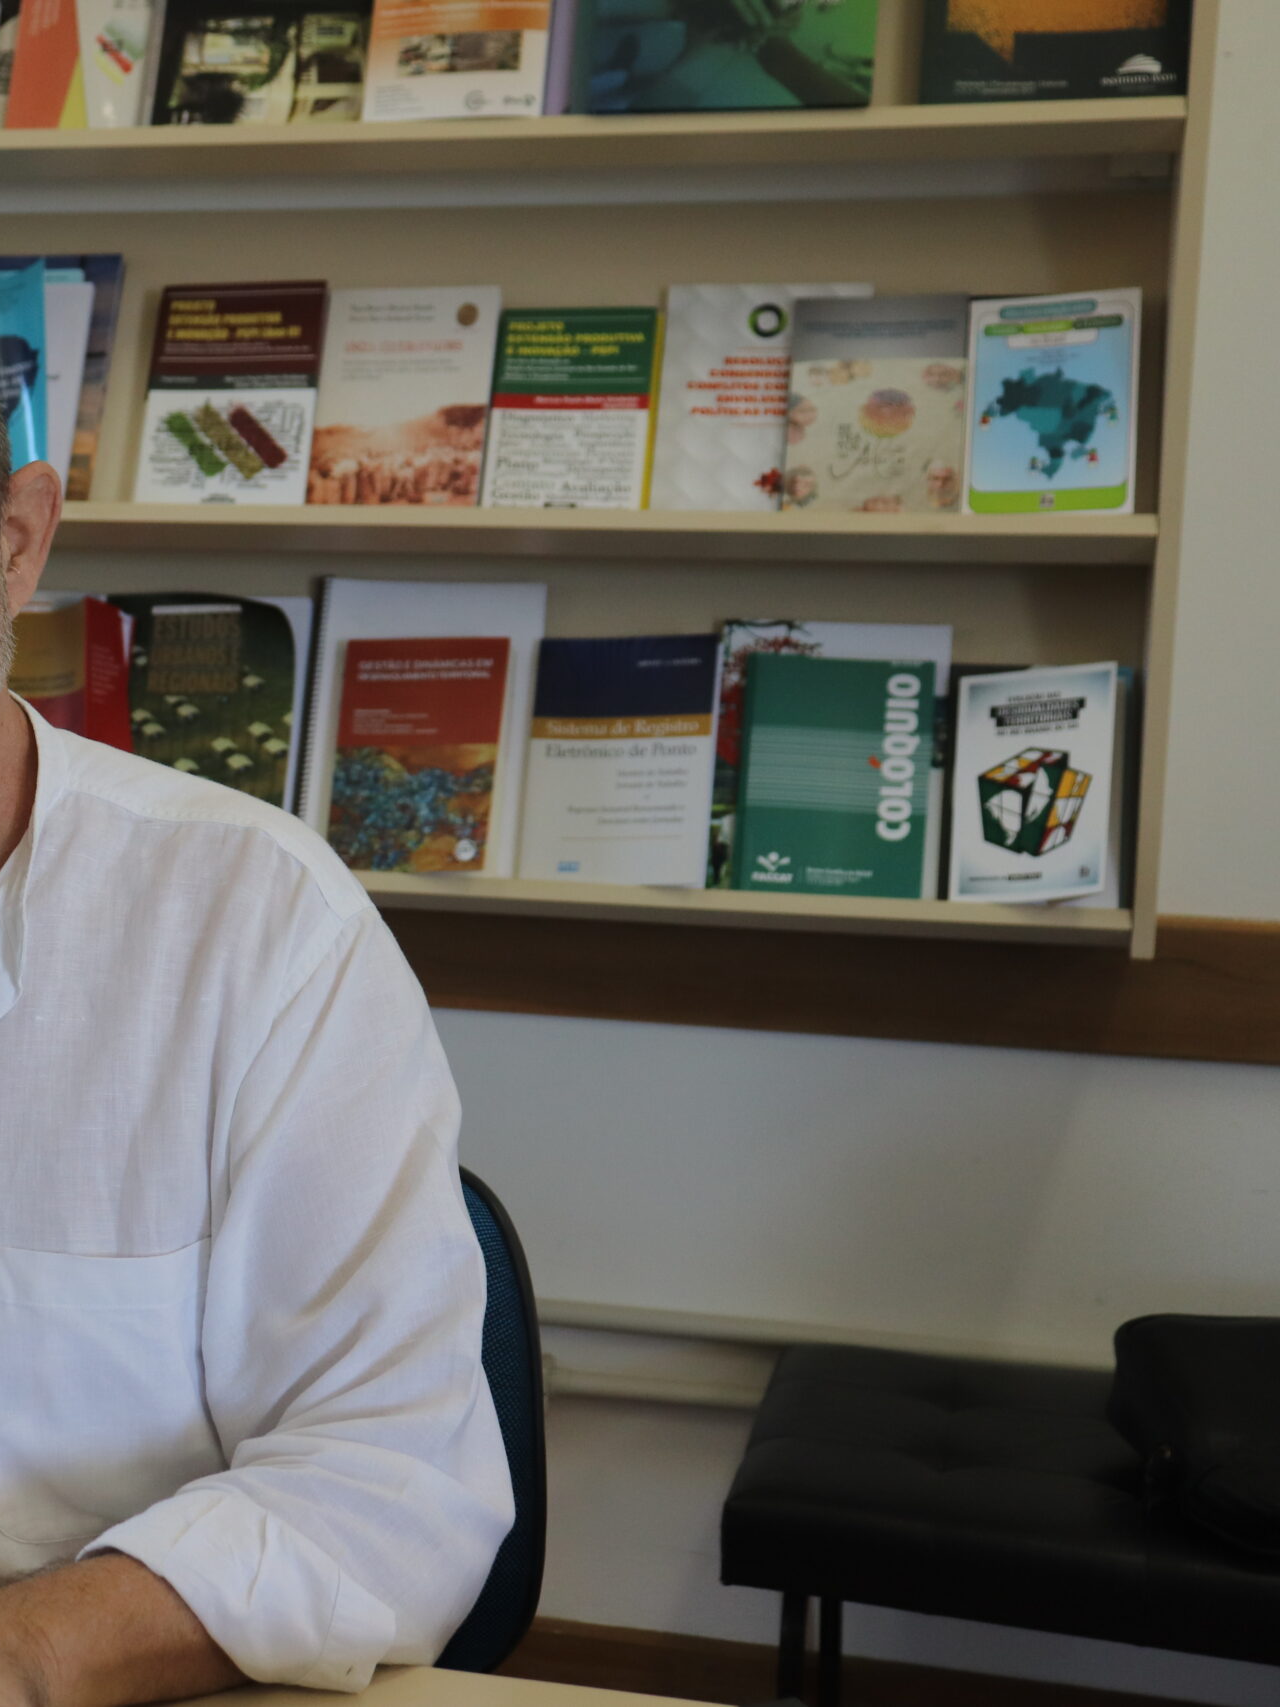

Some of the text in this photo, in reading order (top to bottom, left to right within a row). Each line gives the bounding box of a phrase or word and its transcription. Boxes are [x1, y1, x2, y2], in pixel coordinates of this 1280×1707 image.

[508, 321, 565, 333] PROJETO
[575, 332, 646, 343] PRODUTIVA
[687, 382, 758, 392] CONFLITOS
[716, 395, 788, 404] ENVOLVEN
[690, 405, 760, 417] POLÍTICAS
[155, 616, 241, 640] ESTUDOS
[357, 660, 402, 671] GESTÃO
[147, 671, 239, 694] REGIONAIS
[546, 718, 699, 737] Sistema de Registro
[545, 742, 697, 758] Eletrônico de Ponto
[868, 672, 922, 842] COLÓQUIO
